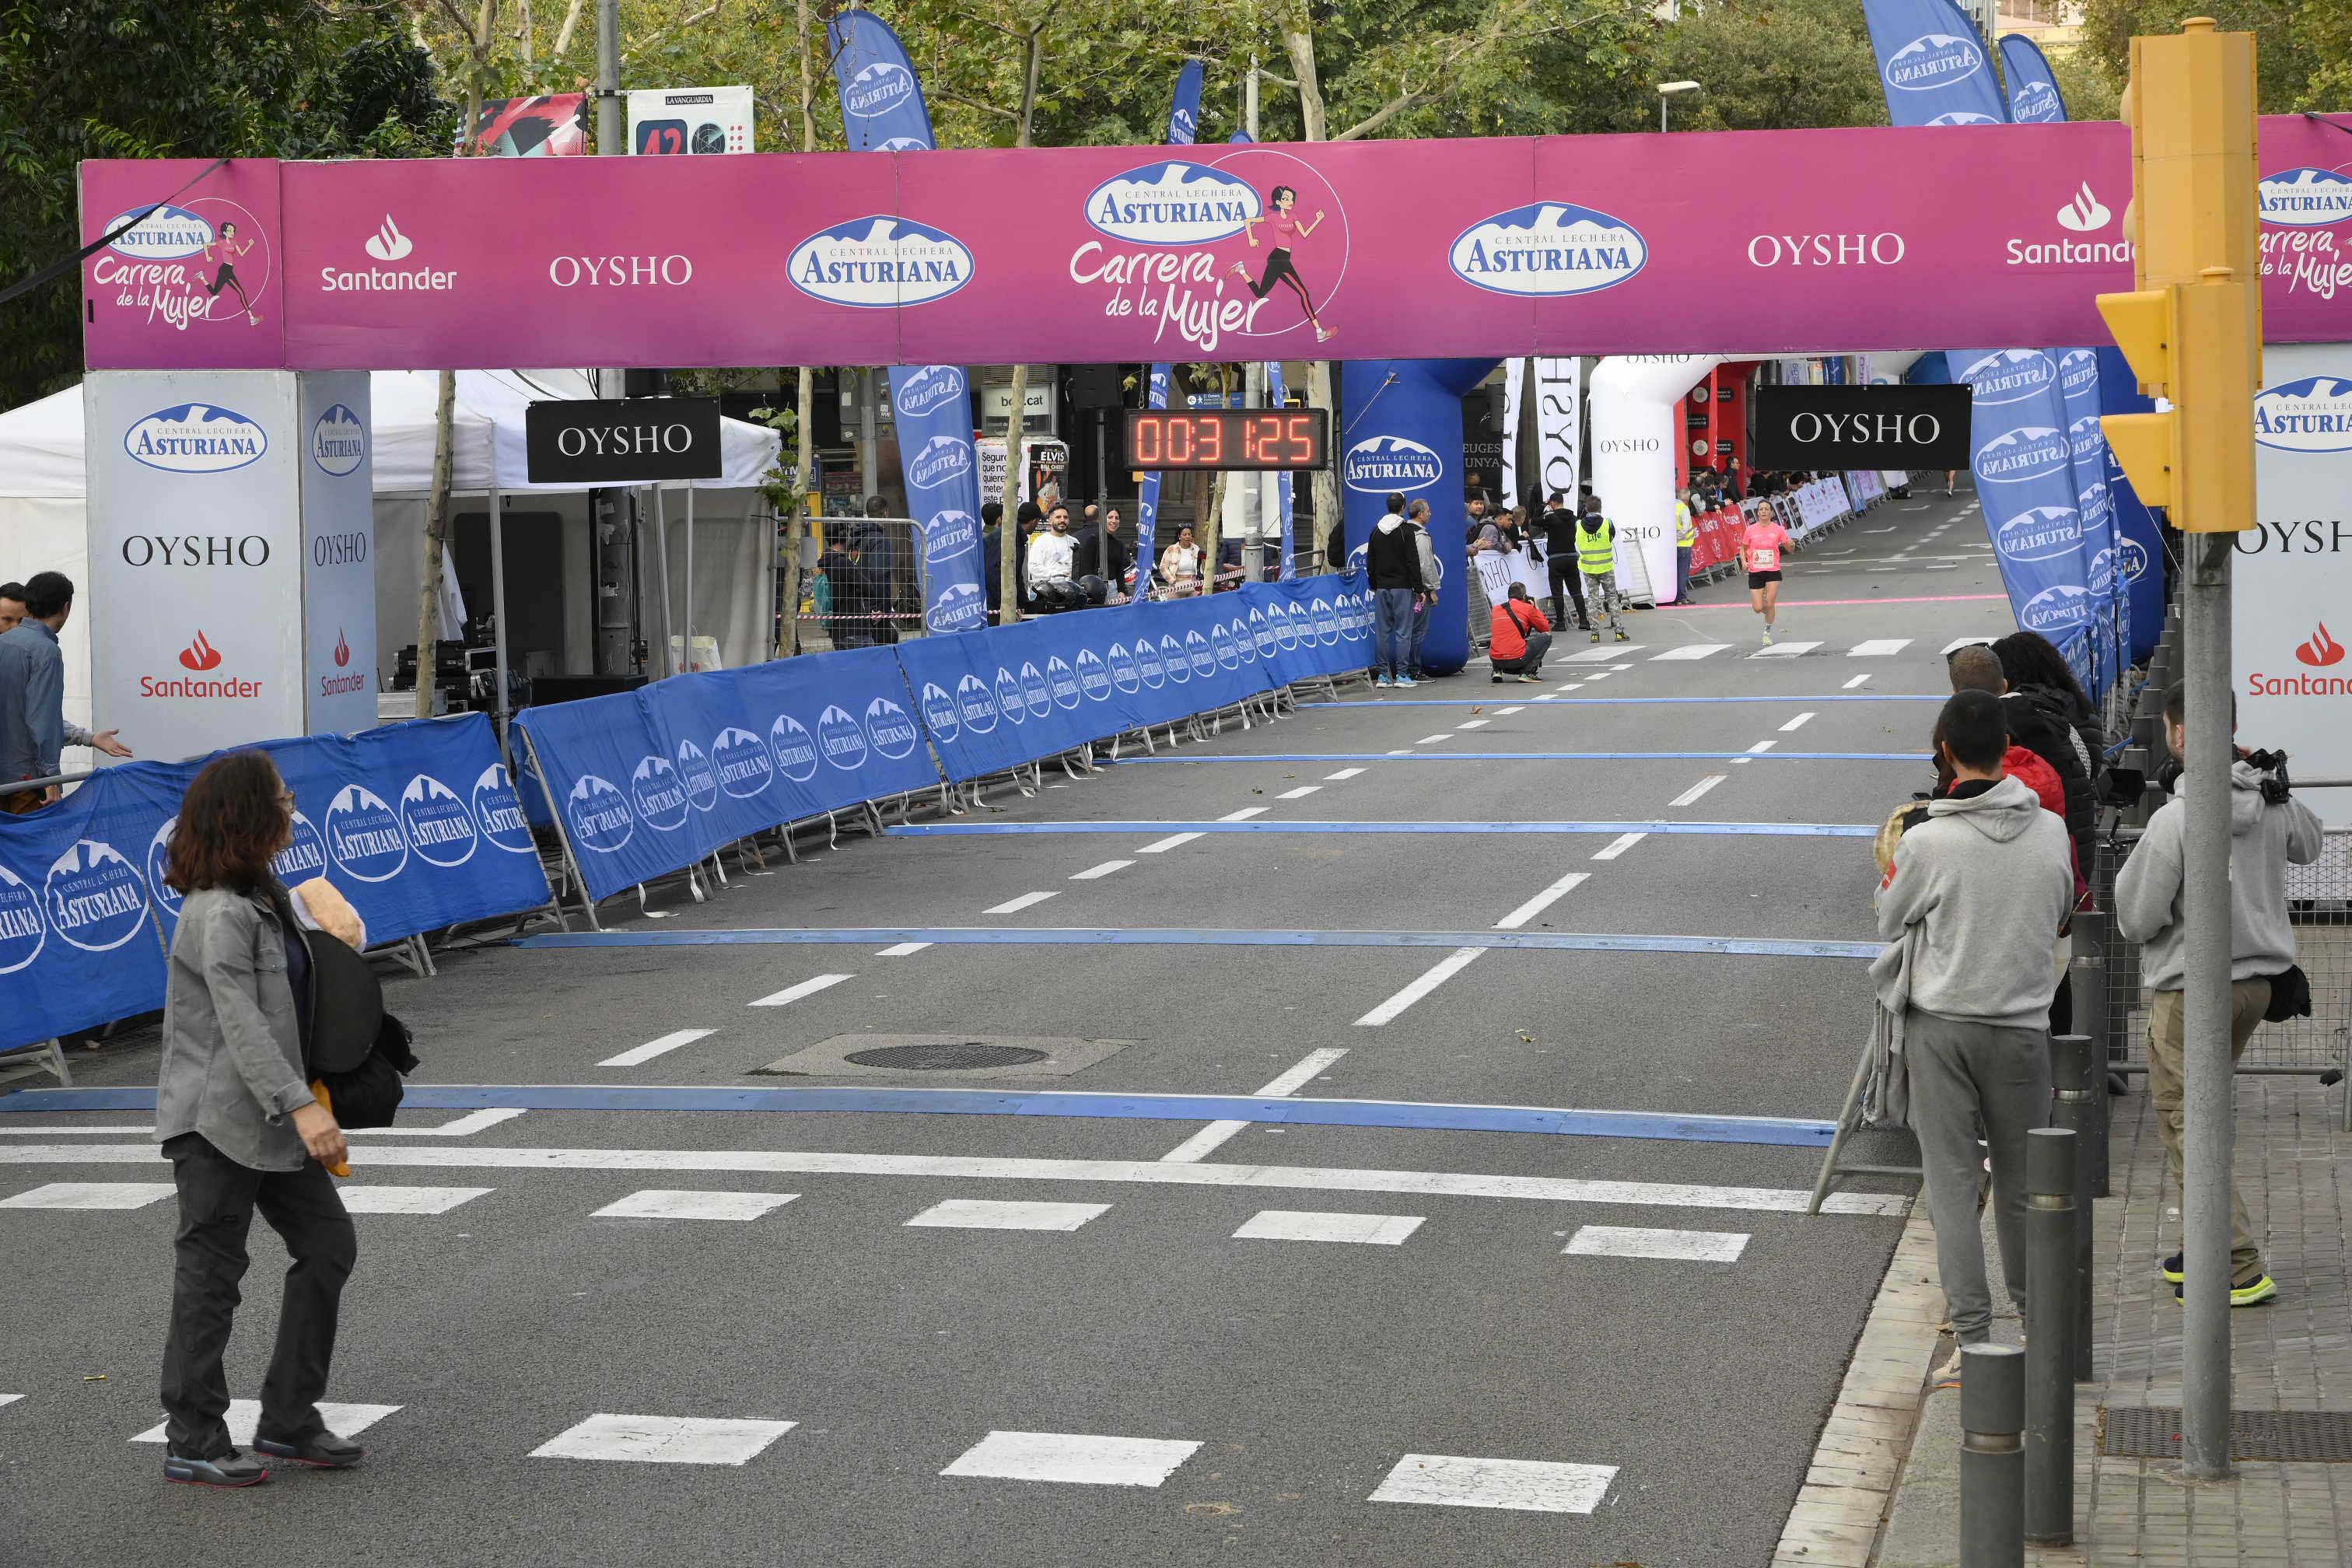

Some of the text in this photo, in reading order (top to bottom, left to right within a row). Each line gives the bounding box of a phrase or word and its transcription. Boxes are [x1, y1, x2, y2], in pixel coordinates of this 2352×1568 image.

[1125, 189, 1242, 199] CENTRAL LECHERA
[1098, 193, 1245, 224] ASTURIANA
[111, 225, 205, 246] ASTURIANA
[1495, 233, 1625, 244] CENTRAL LECHERA
[2259, 230, 2334, 254] arrera
[830, 247, 888, 257] CENTRAL
[1069, 241, 1215, 284] Carrera
[1465, 238, 1632, 272] ASTURIANA
[1748, 233, 1905, 267] OYSHO
[94, 256, 185, 285] Carrera
[322, 267, 457, 291] Santander
[550, 255, 693, 286] OYSHO
[801, 250, 960, 283] ASTURIANA
[2278, 253, 2292, 275] la
[2288, 249, 2352, 300] Muje
[117, 282, 220, 331] de la Mujer
[1105, 278, 1270, 352] de la Mujer
[1001, 395, 1043, 406] b.cat
[1542, 358, 1573, 495] OYSH
[1790, 412, 1940, 444] OYSHO
[135, 429, 257, 456] ASTURIANA
[317, 431, 361, 458] ASTURIANA
[558, 424, 692, 457] OYSHO
[1601, 438, 1659, 454] OYSHO
[983, 464, 996, 474] que
[1041, 451, 1064, 461] ELVIS
[983, 473, 1007, 484] quiere
[1348, 459, 1436, 481] ASTURIANA
[984, 495, 997, 503] este
[1587, 532, 1601, 543] Life
[1624, 527, 1661, 541] SHO
[122, 535, 270, 567] OYSHO
[314, 532, 366, 567] OYSHO
[140, 676, 262, 698] Santander
[321, 672, 365, 697] Santander
[775, 741, 815, 768] ASTURIANA
[823, 731, 865, 757] ASTURIANA
[716, 755, 771, 785] ASTURIANA
[408, 812, 473, 846] ASTURIANA
[481, 800, 527, 835] ASTUR
[333, 824, 404, 862] ASTURIANA
[271, 842, 324, 876] URIANA
